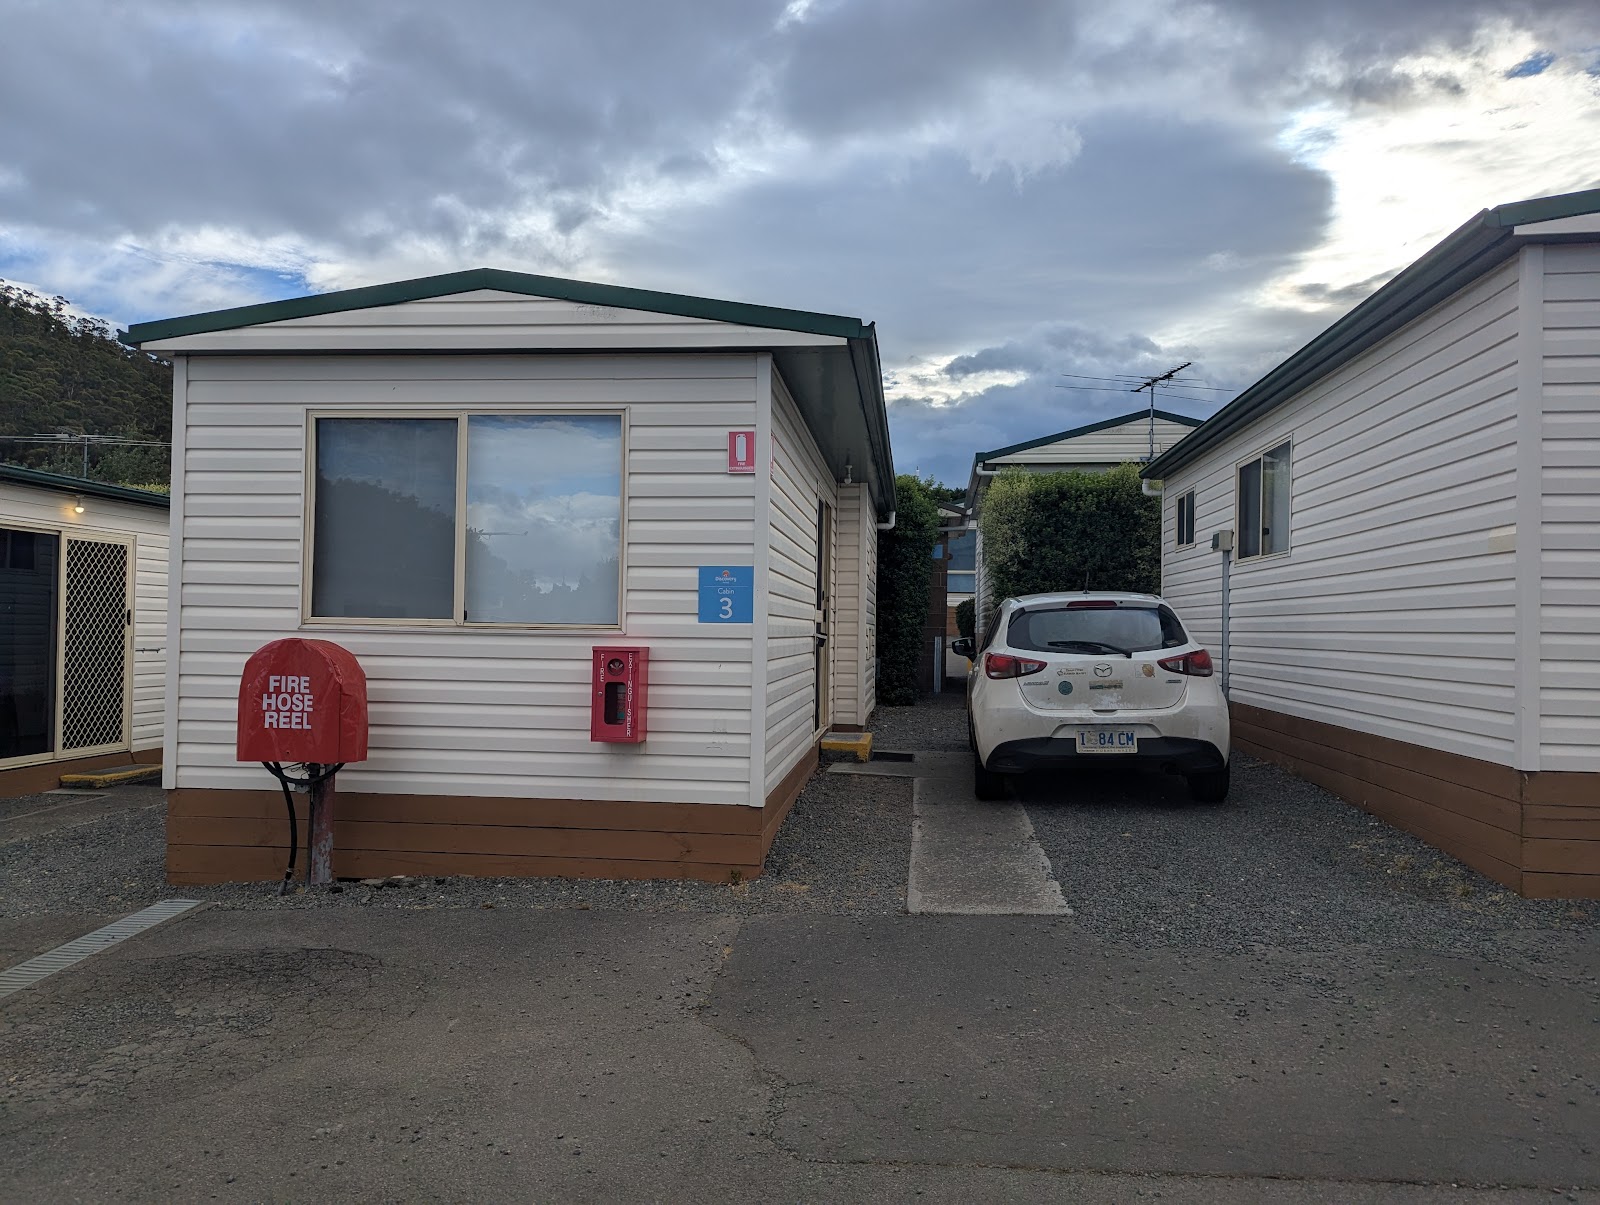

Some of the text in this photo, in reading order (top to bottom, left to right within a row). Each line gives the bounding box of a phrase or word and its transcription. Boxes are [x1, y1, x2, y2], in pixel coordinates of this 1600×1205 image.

[717, 587, 735, 595] Cabin
[718, 597, 733, 619] 3
[269, 675, 310, 694] FIRE
[262, 693, 314, 712] HOSE
[264, 711, 312, 730] REEL
[1098, 732, 1115, 746] 84
[1118, 732, 1134, 746] CM
